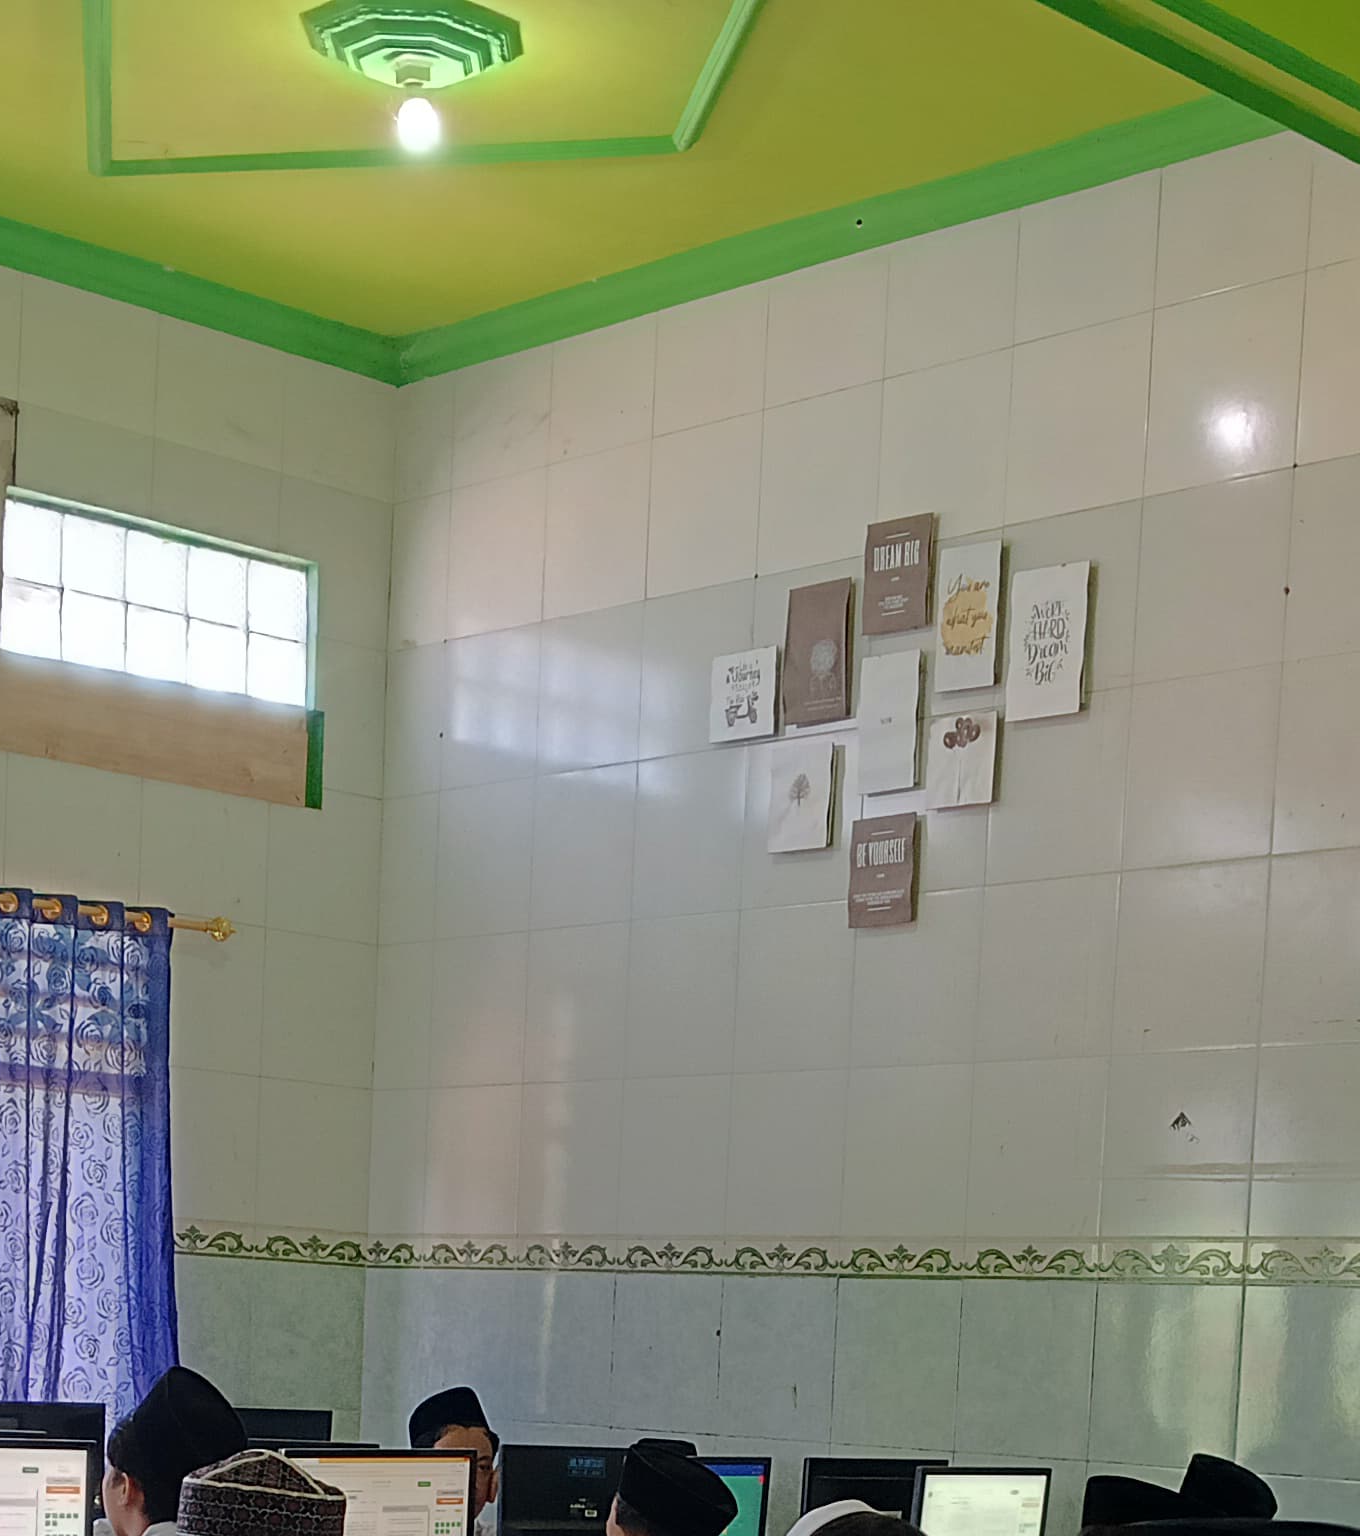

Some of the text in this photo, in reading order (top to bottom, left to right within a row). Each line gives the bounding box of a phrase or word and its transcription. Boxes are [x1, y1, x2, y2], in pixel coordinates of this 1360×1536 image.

[873, 539, 921, 572] DREAM BIG
[856, 837, 906, 868] BE YOURSELF
